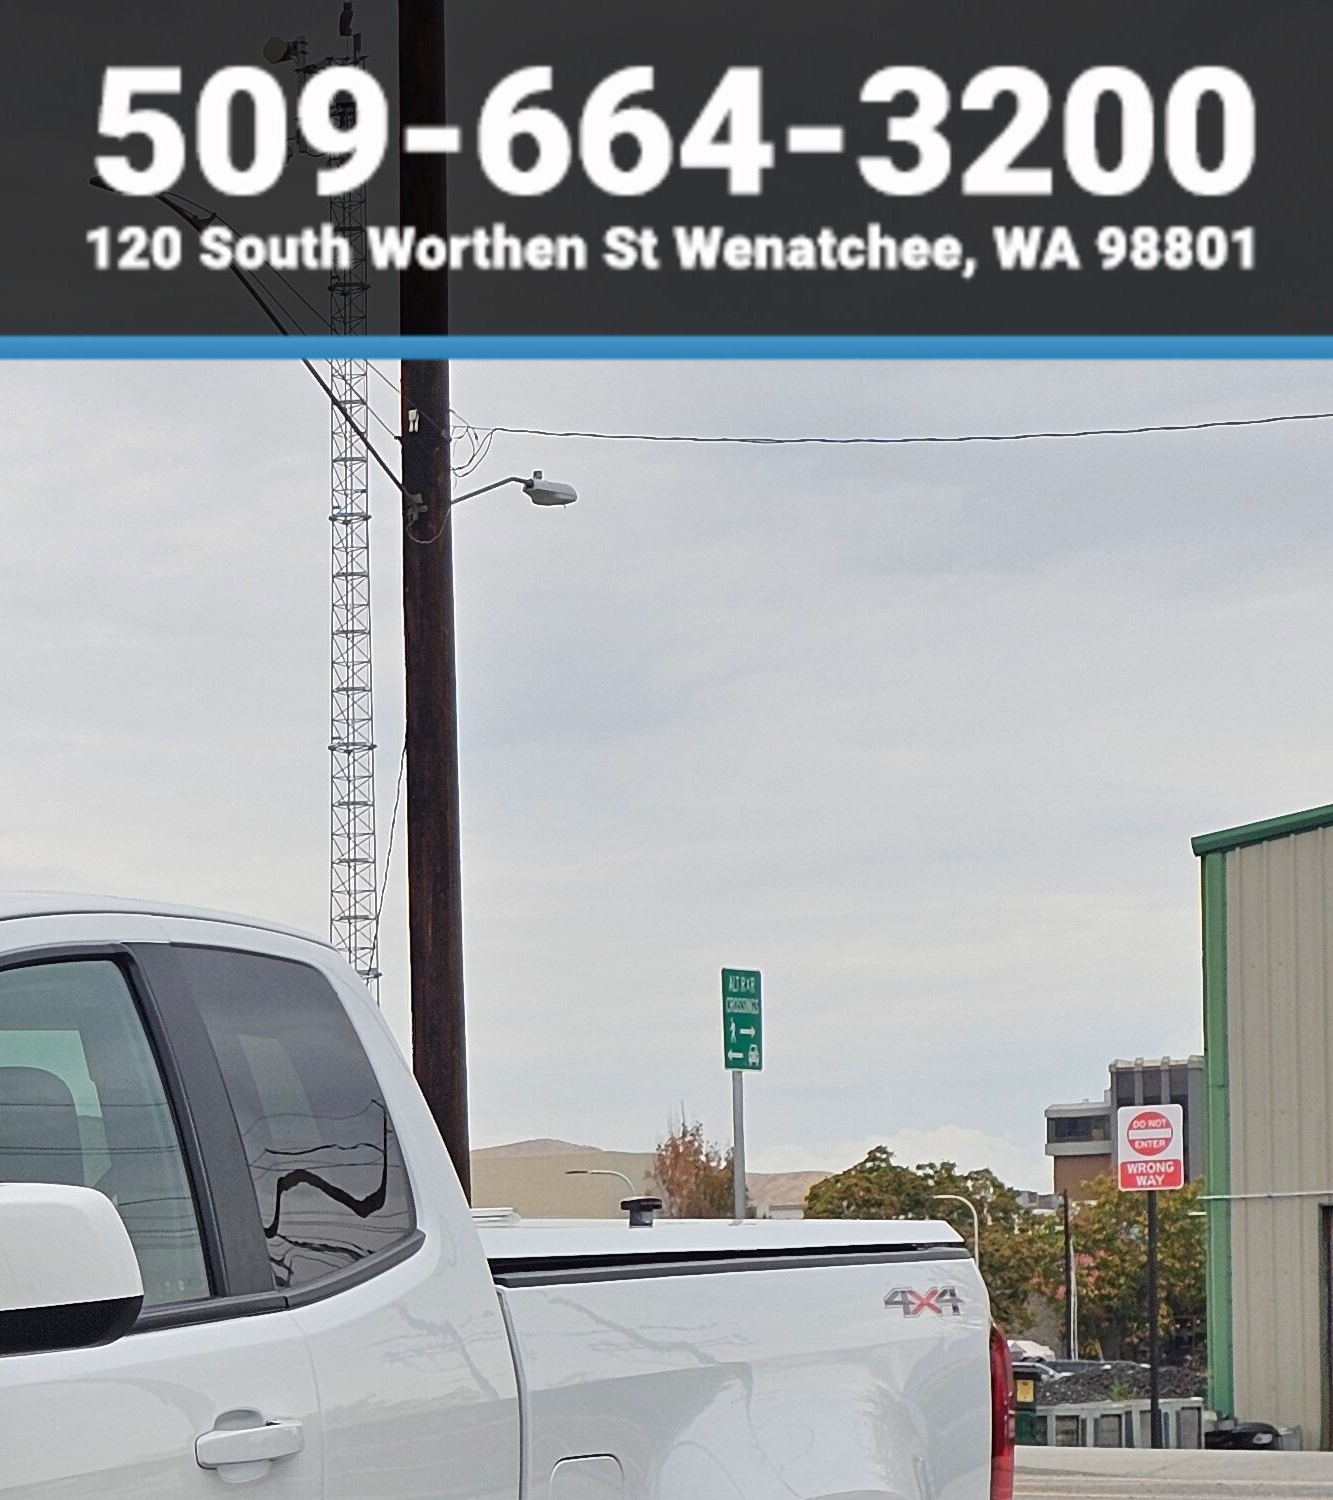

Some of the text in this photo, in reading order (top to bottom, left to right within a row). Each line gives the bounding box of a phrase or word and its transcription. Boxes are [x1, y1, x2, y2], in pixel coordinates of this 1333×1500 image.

[1133, 1119, 1167, 1129] DO NOT
[1135, 1140, 1166, 1149] ENTER
[1127, 1161, 1175, 1174] WRONG
[1136, 1175, 1165, 1186] WAY
